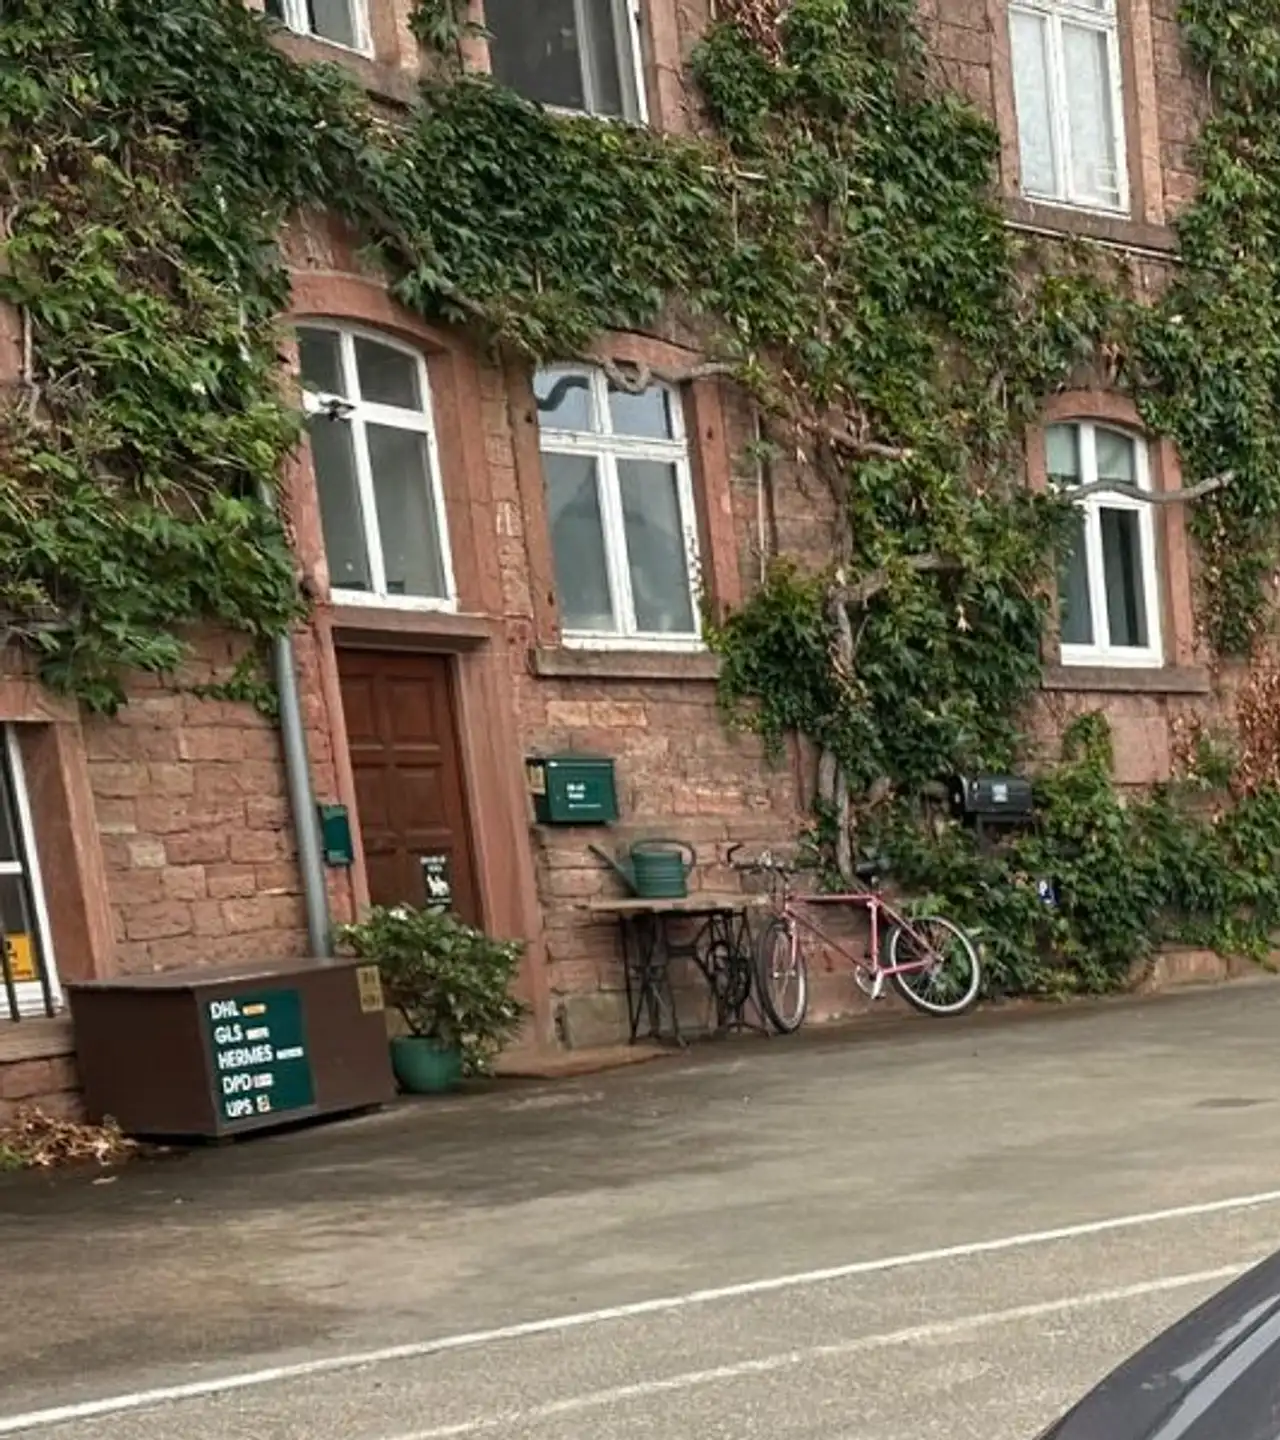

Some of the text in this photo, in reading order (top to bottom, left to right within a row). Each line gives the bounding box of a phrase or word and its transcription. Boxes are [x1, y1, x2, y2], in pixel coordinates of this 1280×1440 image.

[210, 999, 240, 1019] DHL
[214, 1024, 243, 1044] GLS
[218, 1044, 273, 1069] HERMES
[222, 1073, 252, 1094] DPD
[225, 1097, 253, 1117] UPS
